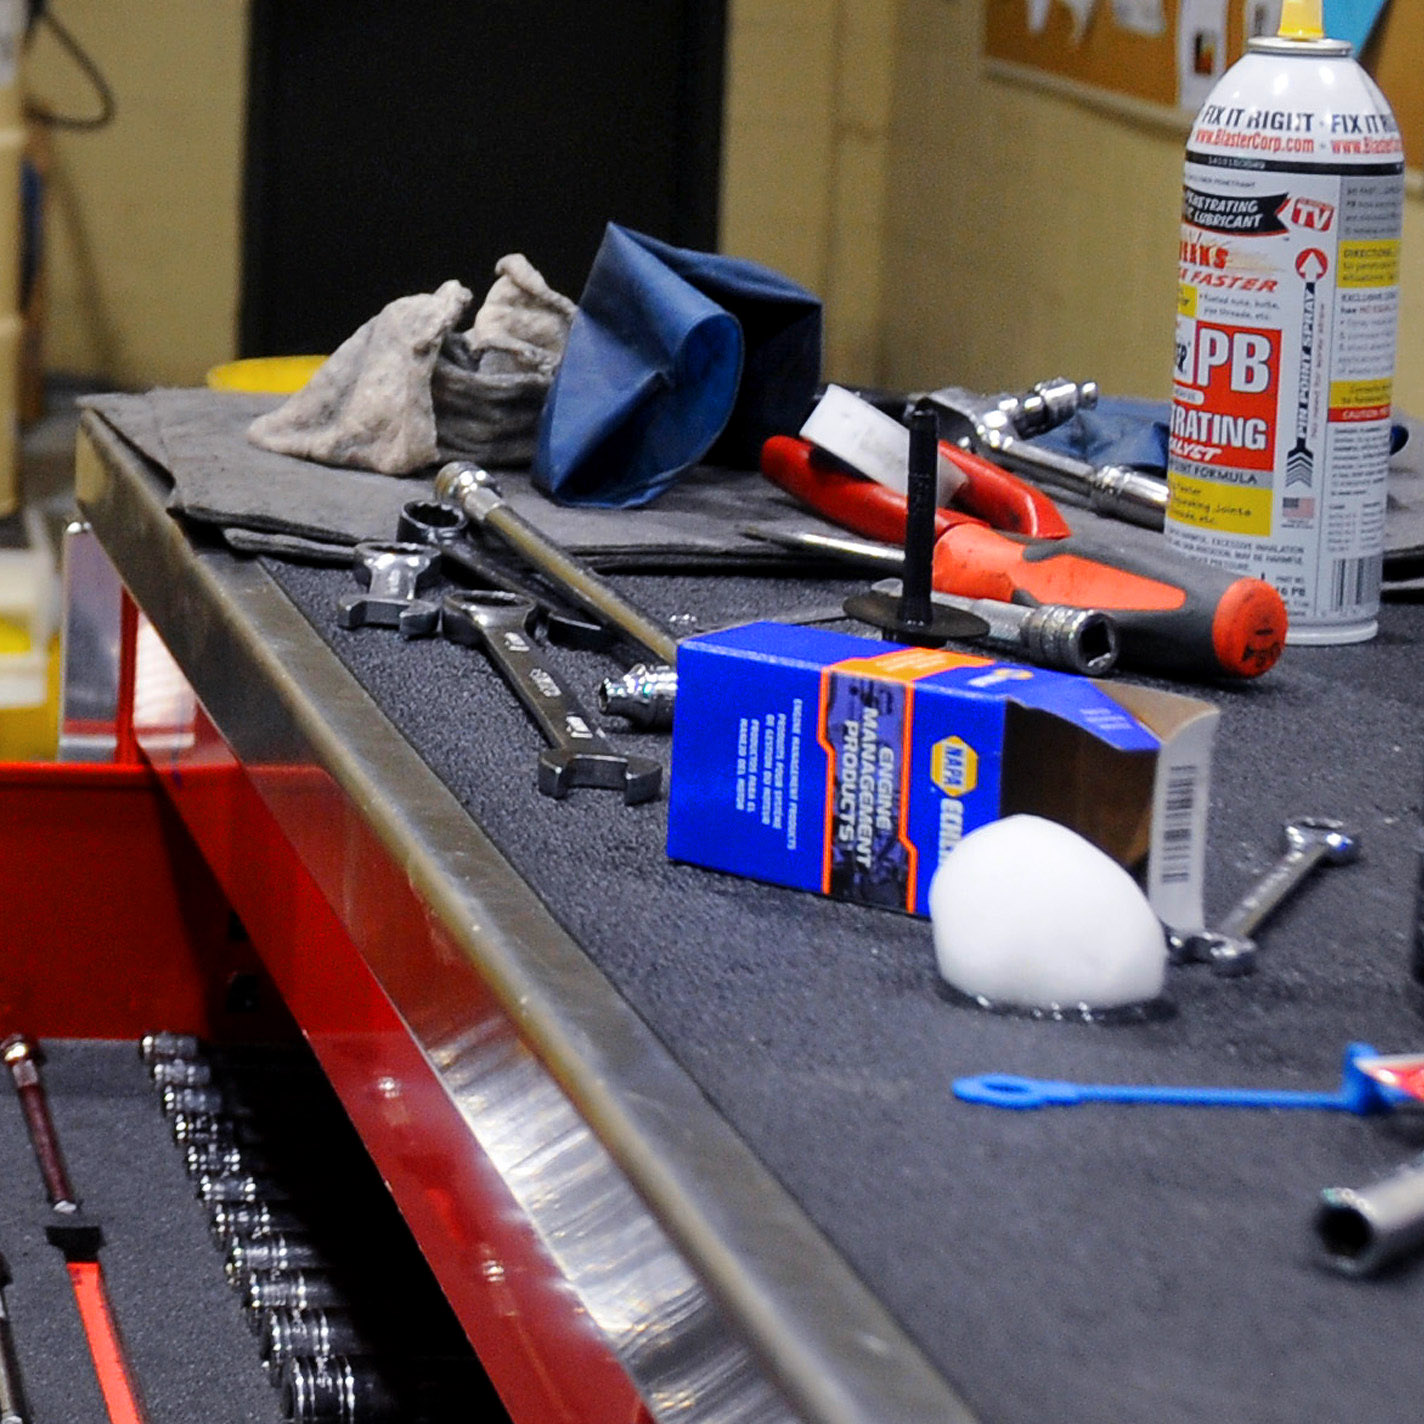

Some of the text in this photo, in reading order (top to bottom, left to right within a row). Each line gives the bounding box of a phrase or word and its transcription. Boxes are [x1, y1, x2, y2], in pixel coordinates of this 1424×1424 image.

[1331, 114, 1363, 134] FIX
[1193, 208, 1264, 229] LUBRICANT
[1295, 202, 1332, 231] TV
[1190, 270, 1278, 293] FASTER
[1196, 328, 1272, 394] PB
[1296, 288, 1315, 439] PIN POINT SPRAY
[1194, 466, 1258, 484] FORMULA
[838, 719, 859, 842] PRODUCTS
[855, 706, 880, 868] MANAGEMENT
[944, 744, 964, 787] NAPA
[876, 746, 894, 830] ENGINE
